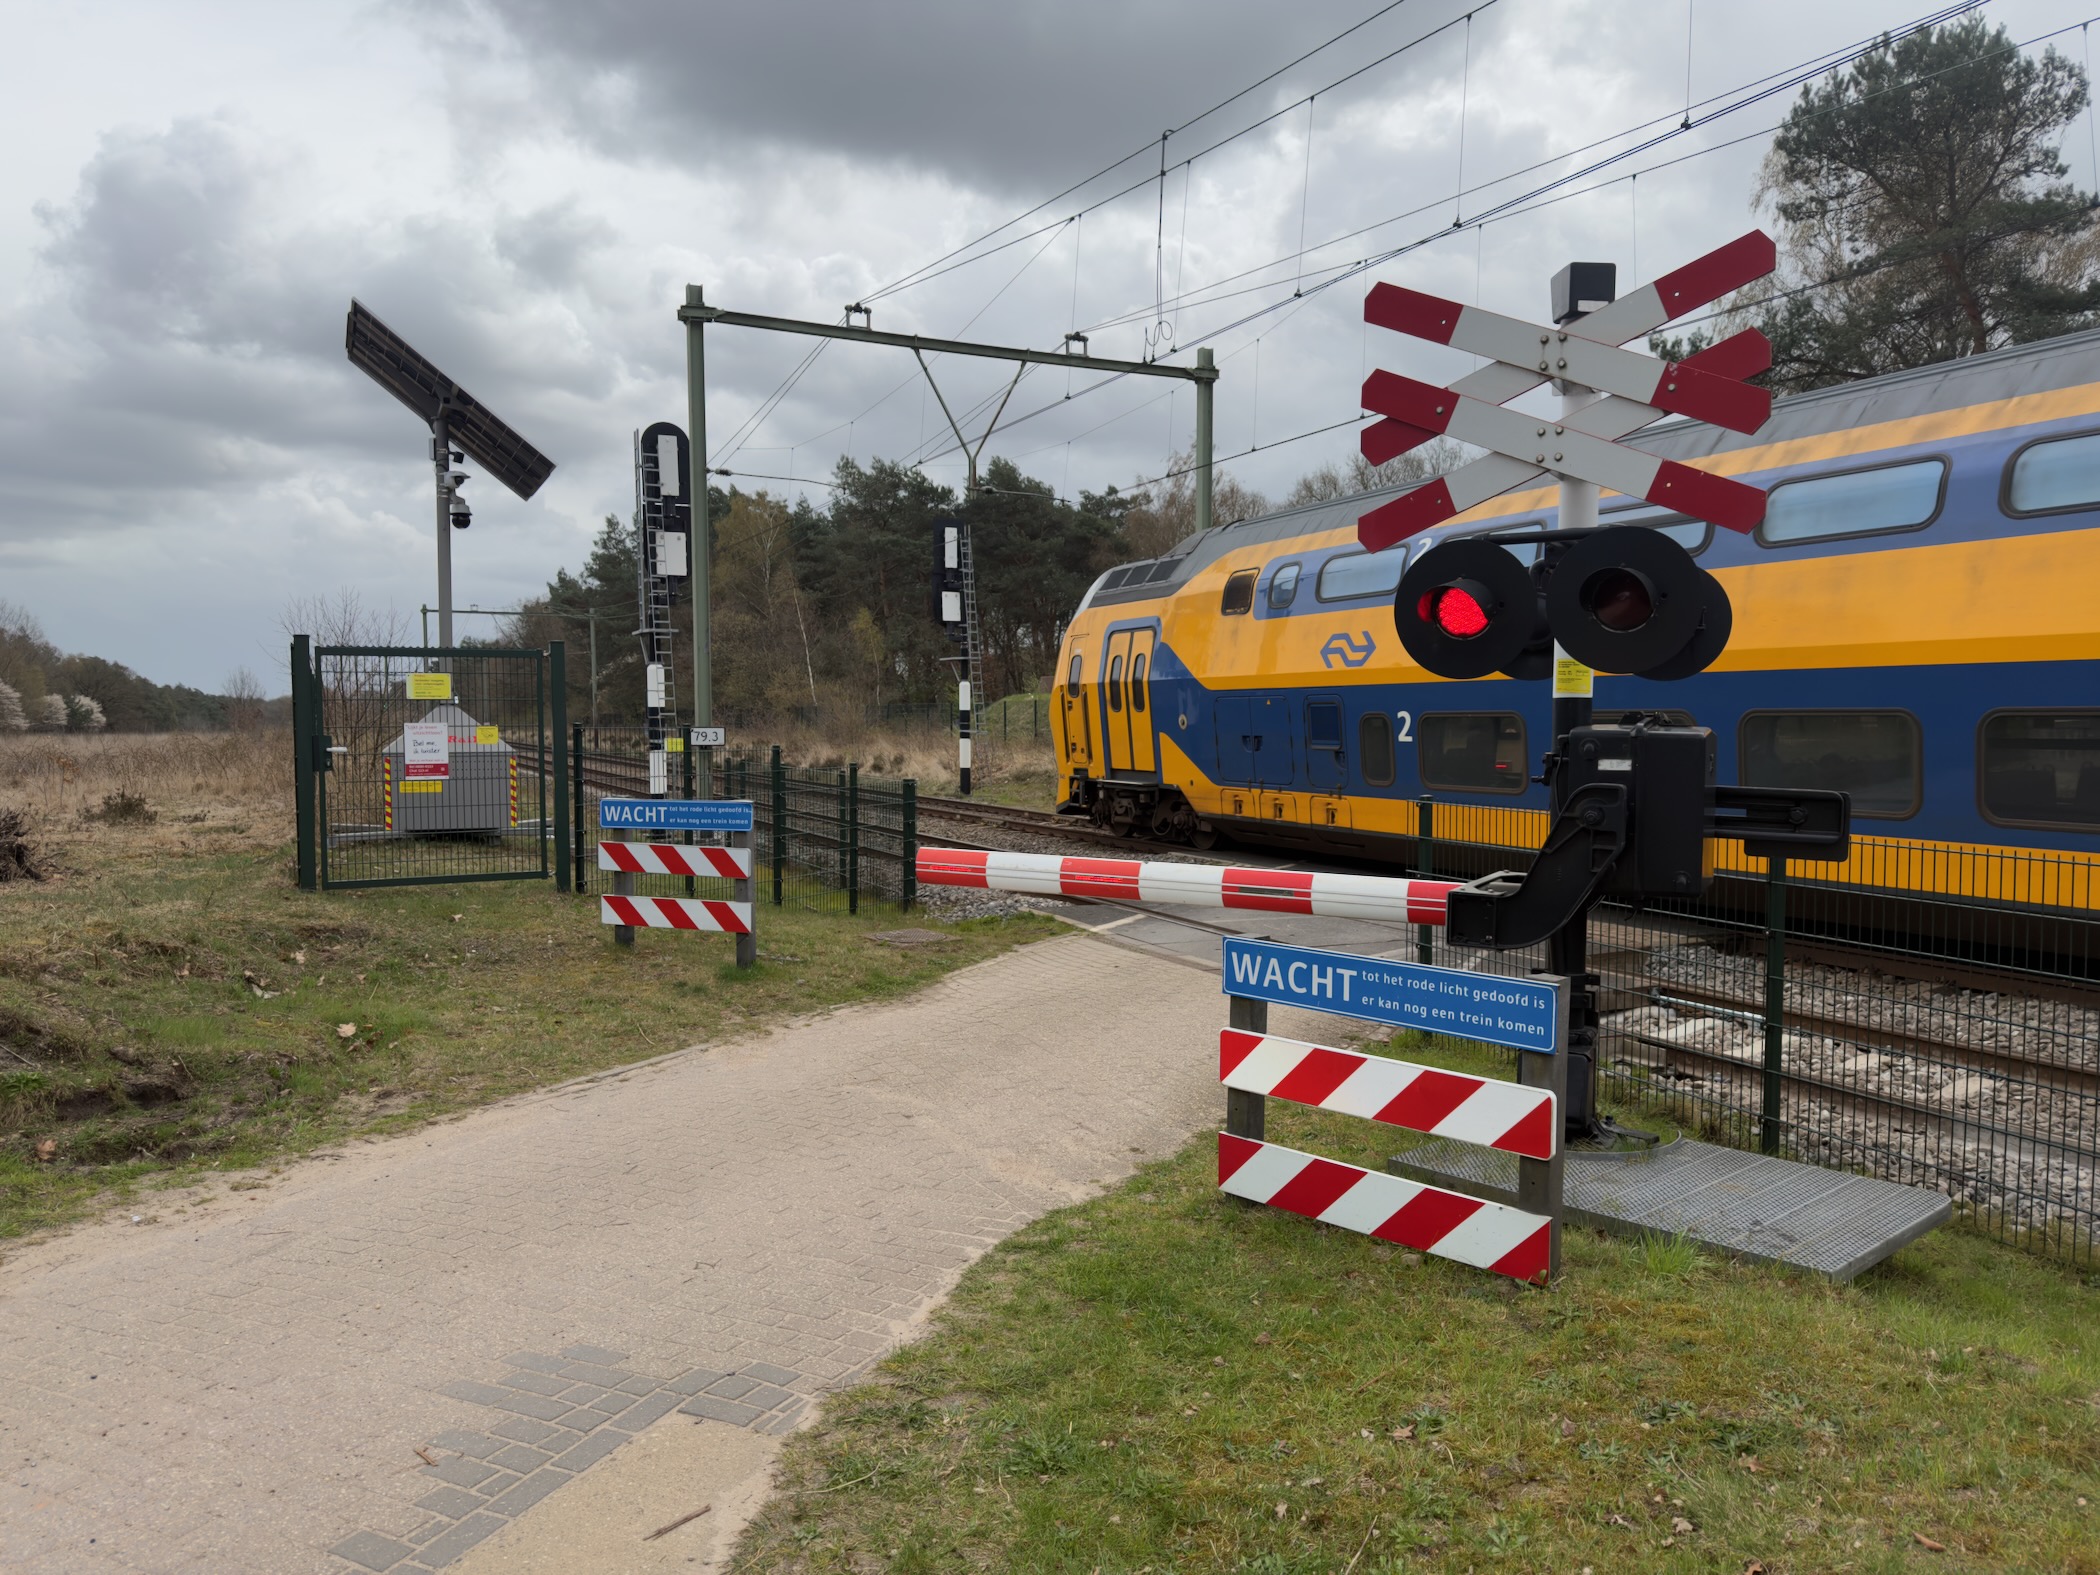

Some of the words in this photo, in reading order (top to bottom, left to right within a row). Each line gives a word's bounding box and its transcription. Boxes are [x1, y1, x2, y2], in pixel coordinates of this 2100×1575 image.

[694, 731, 719, 742] 79.3
[1397, 710, 1413, 742] 2
[604, 805, 668, 823] WACHT
[1231, 951, 1358, 1002] WACHT
[1362, 970, 1379, 983] tot
[1383, 973, 1403, 987] het
[1407, 979, 1436, 992] rode
[1439, 981, 1469, 997] licht
[1473, 989, 1529, 1007] gedoofd
[1533, 996, 1545, 1009] is
[1362, 996, 1375, 1006] er
[1378, 996, 1400, 1011] kan
[1404, 1003, 1427, 1018] nog
[1432, 1008, 1455, 1020] een
[1460, 1011, 1493, 1027] trein
[1498, 1017, 1545, 1036] komen
